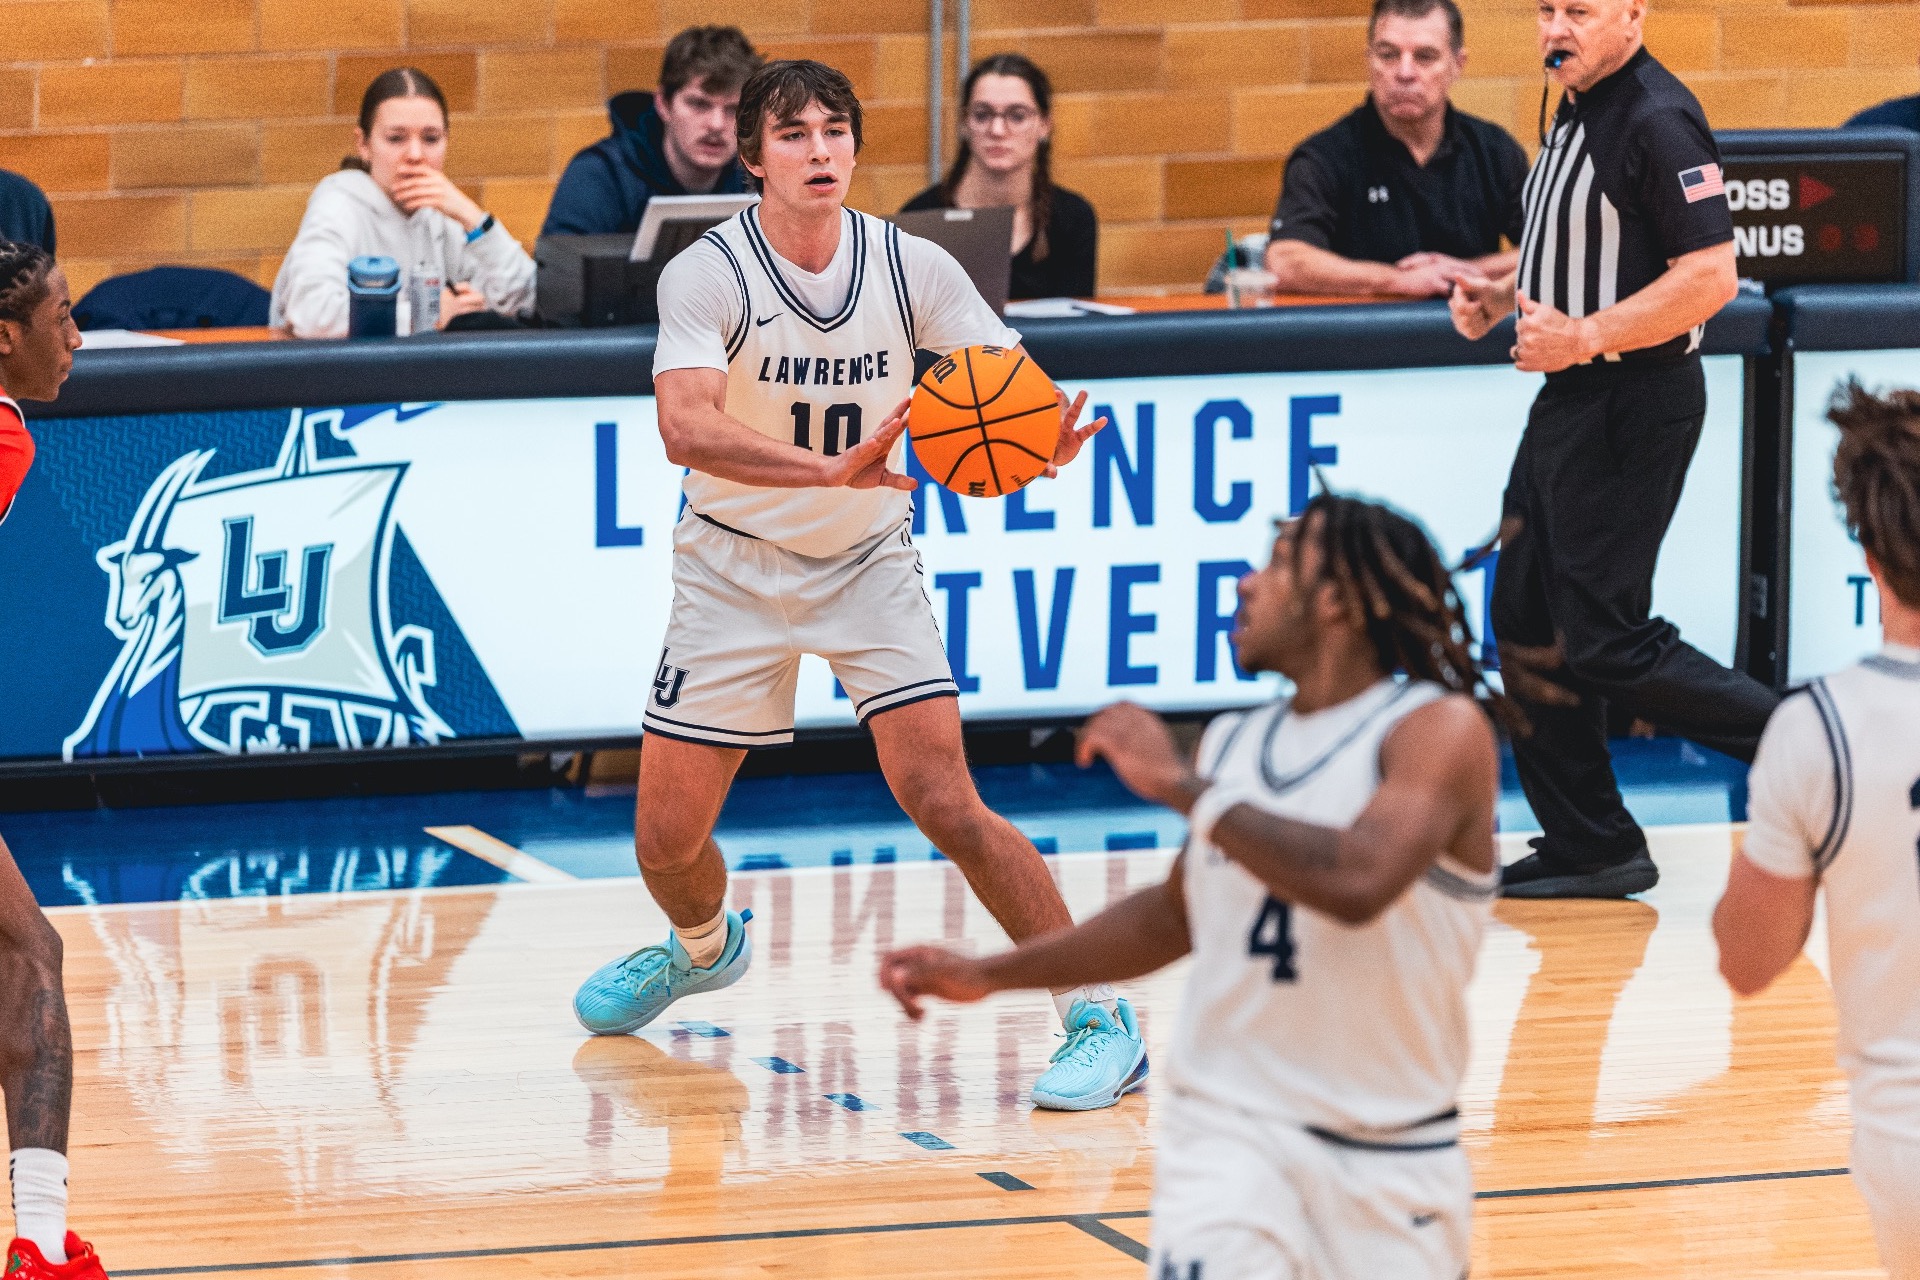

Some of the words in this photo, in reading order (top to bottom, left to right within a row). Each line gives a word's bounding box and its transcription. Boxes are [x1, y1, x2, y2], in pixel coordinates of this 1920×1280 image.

[1725, 179, 1790, 211] OSS
[1733, 225, 1804, 257] NUS
[758, 350, 889, 386] LAWRENCE
[791, 402, 862, 457] 10
[218, 515, 335, 657] LU
[1247, 895, 1298, 982] 4
